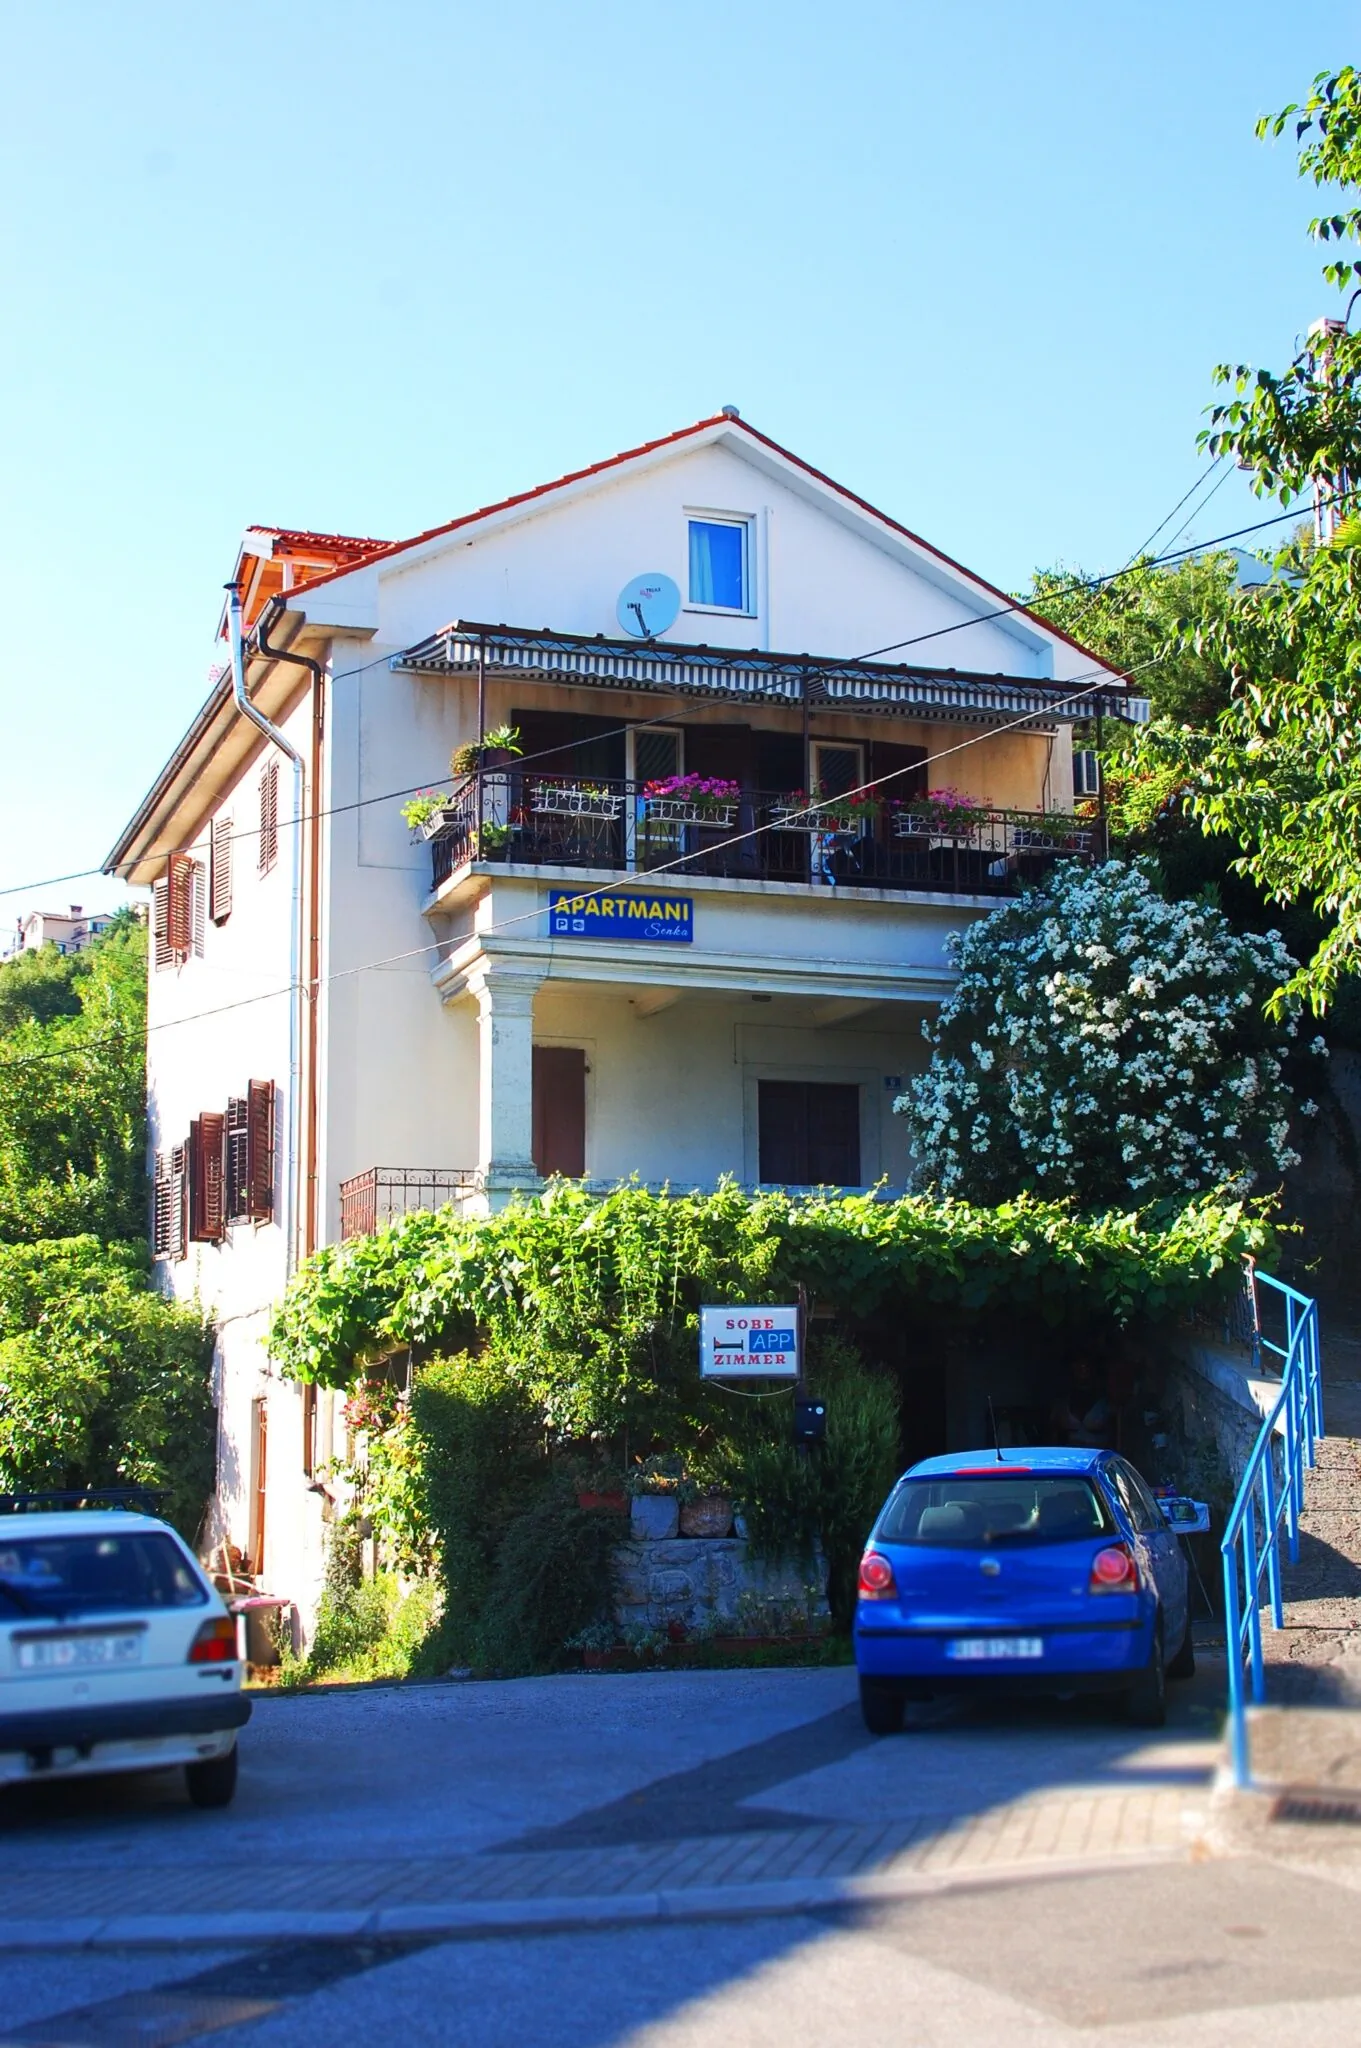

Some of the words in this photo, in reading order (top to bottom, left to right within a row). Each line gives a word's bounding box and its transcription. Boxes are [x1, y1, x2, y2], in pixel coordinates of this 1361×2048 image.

[555, 896, 689, 921] APARTMANI
[644, 922, 688, 937] Senka
[726, 1319, 774, 1330] SOBE
[752, 1333, 791, 1350] APP
[713, 1354, 786, 1365] ZIMMER
